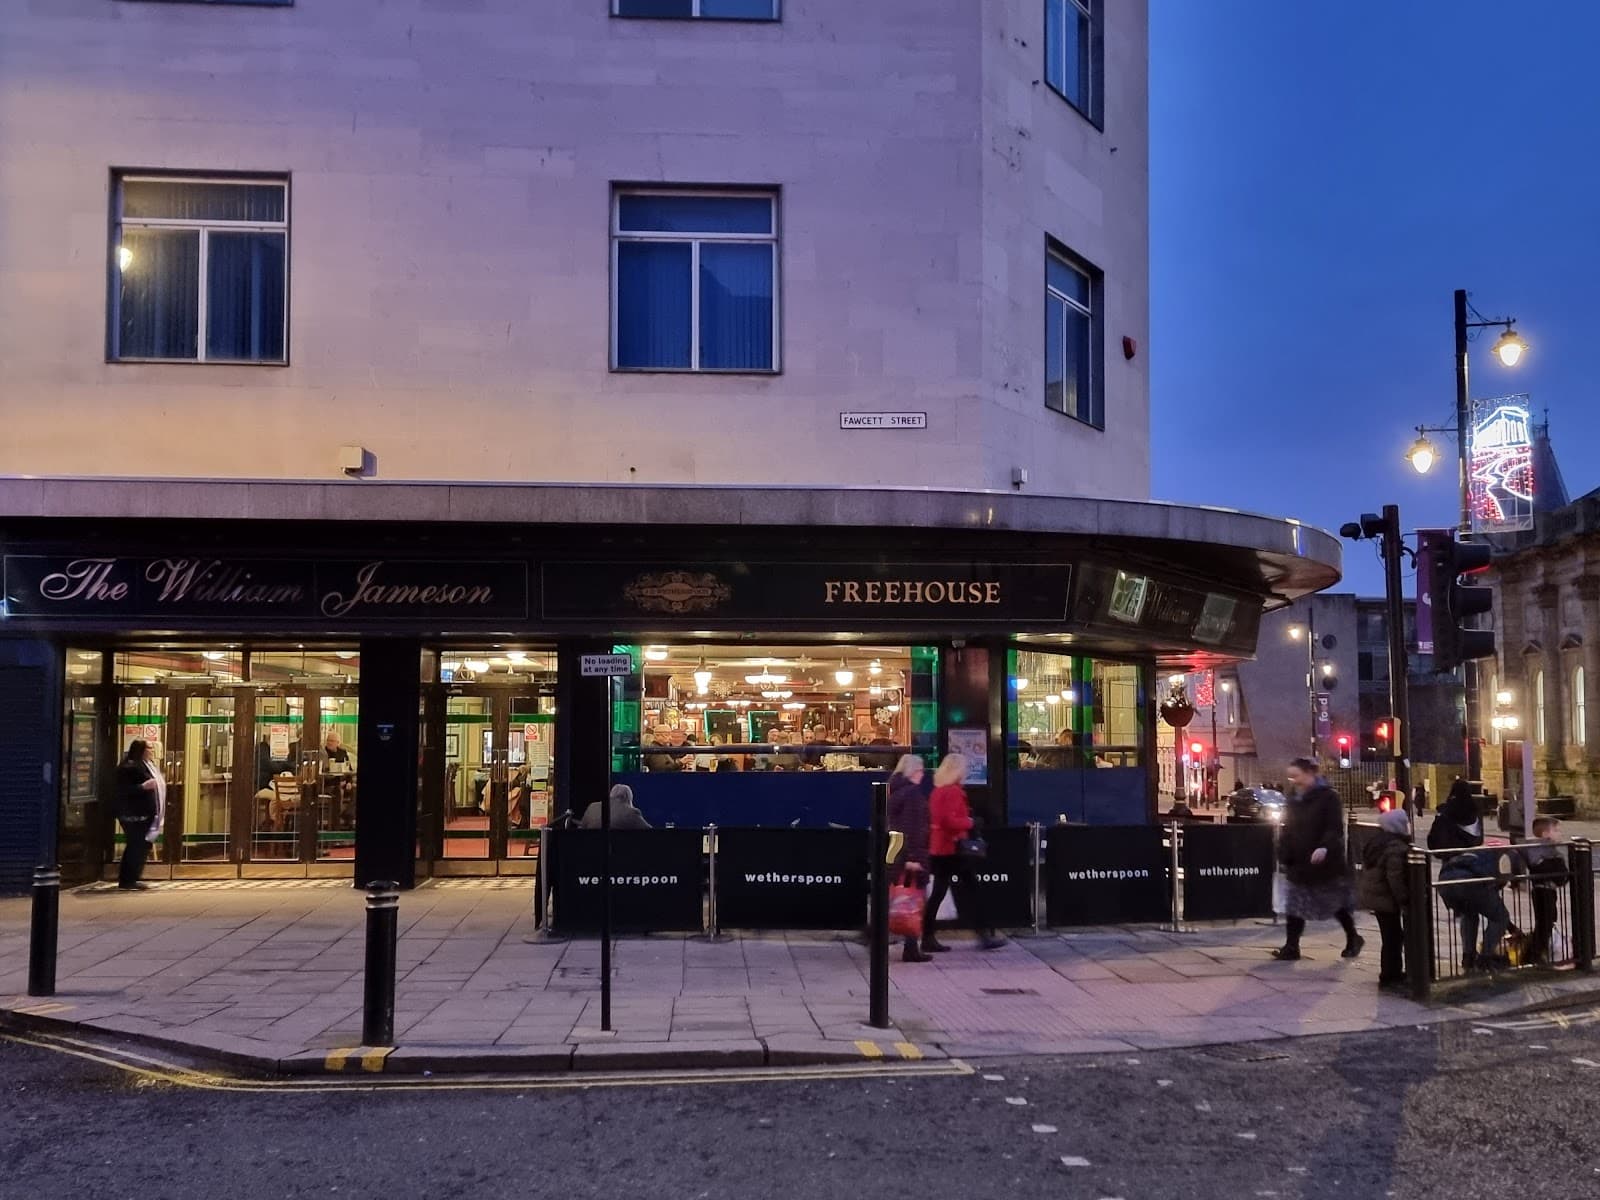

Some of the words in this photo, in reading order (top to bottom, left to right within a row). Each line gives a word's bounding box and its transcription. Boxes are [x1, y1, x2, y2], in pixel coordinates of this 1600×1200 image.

[891, 416, 921, 424] STREET
[40, 558, 129, 601] The
[145, 558, 304, 602] William
[320, 560, 493, 618] Jameson
[824, 580, 1001, 604] FREEHOUSE
[585, 657, 596, 665] No
[598, 657, 627, 665] loading
[594, 666, 608, 674] any
[610, 665, 628, 673] time
[1069, 867, 1149, 880] wetherspoon
[1199, 865, 1260, 877] wetherspoon
[578, 875, 678, 887] weerspoon
[744, 872, 842, 885] wetherspoon
